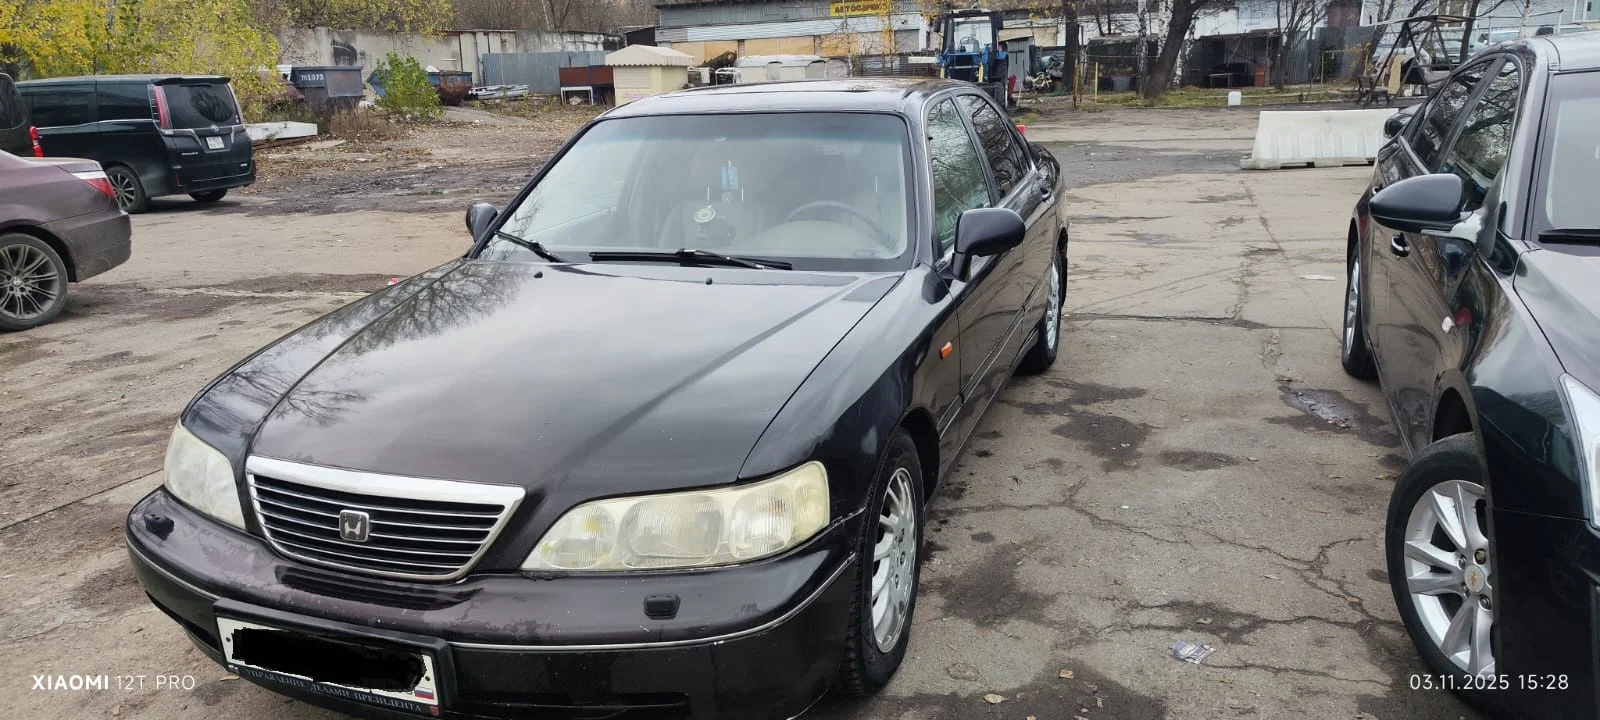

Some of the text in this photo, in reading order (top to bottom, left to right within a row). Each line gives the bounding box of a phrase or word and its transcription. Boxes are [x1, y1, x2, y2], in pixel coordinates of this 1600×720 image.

[245, 668, 422, 712] УПРАВЛЕНИЕ ДЕЛАМИ ПРЕЗИДЕНТА
